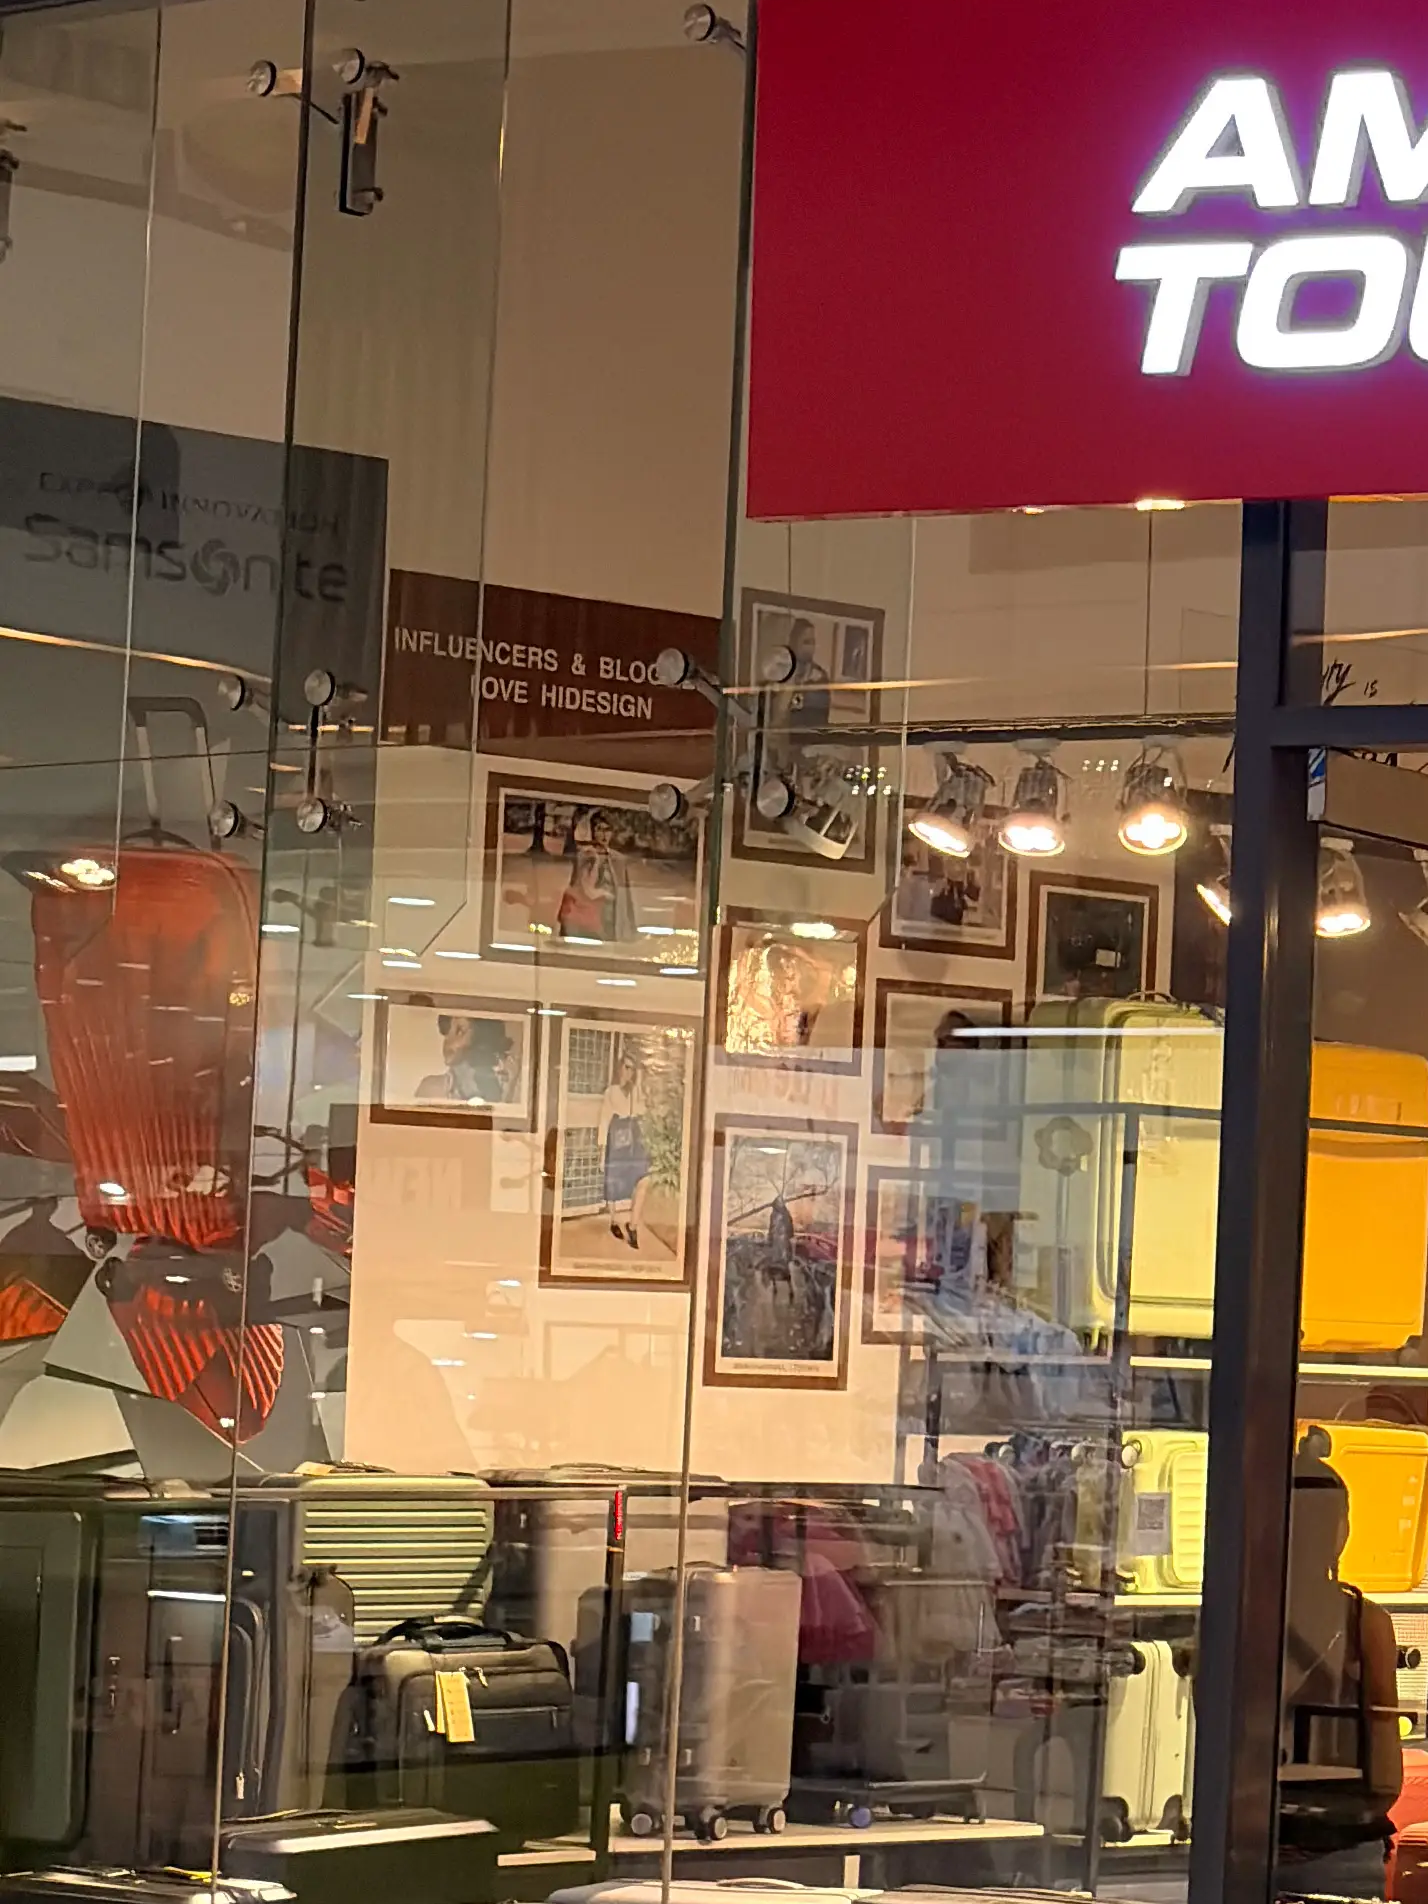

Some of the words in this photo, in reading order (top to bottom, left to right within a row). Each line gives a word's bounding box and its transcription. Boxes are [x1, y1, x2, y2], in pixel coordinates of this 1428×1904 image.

[394, 626, 558, 673] INFLUENCERS
[571, 653, 587, 677] &
[541, 684, 654, 720] HIDESIGN
